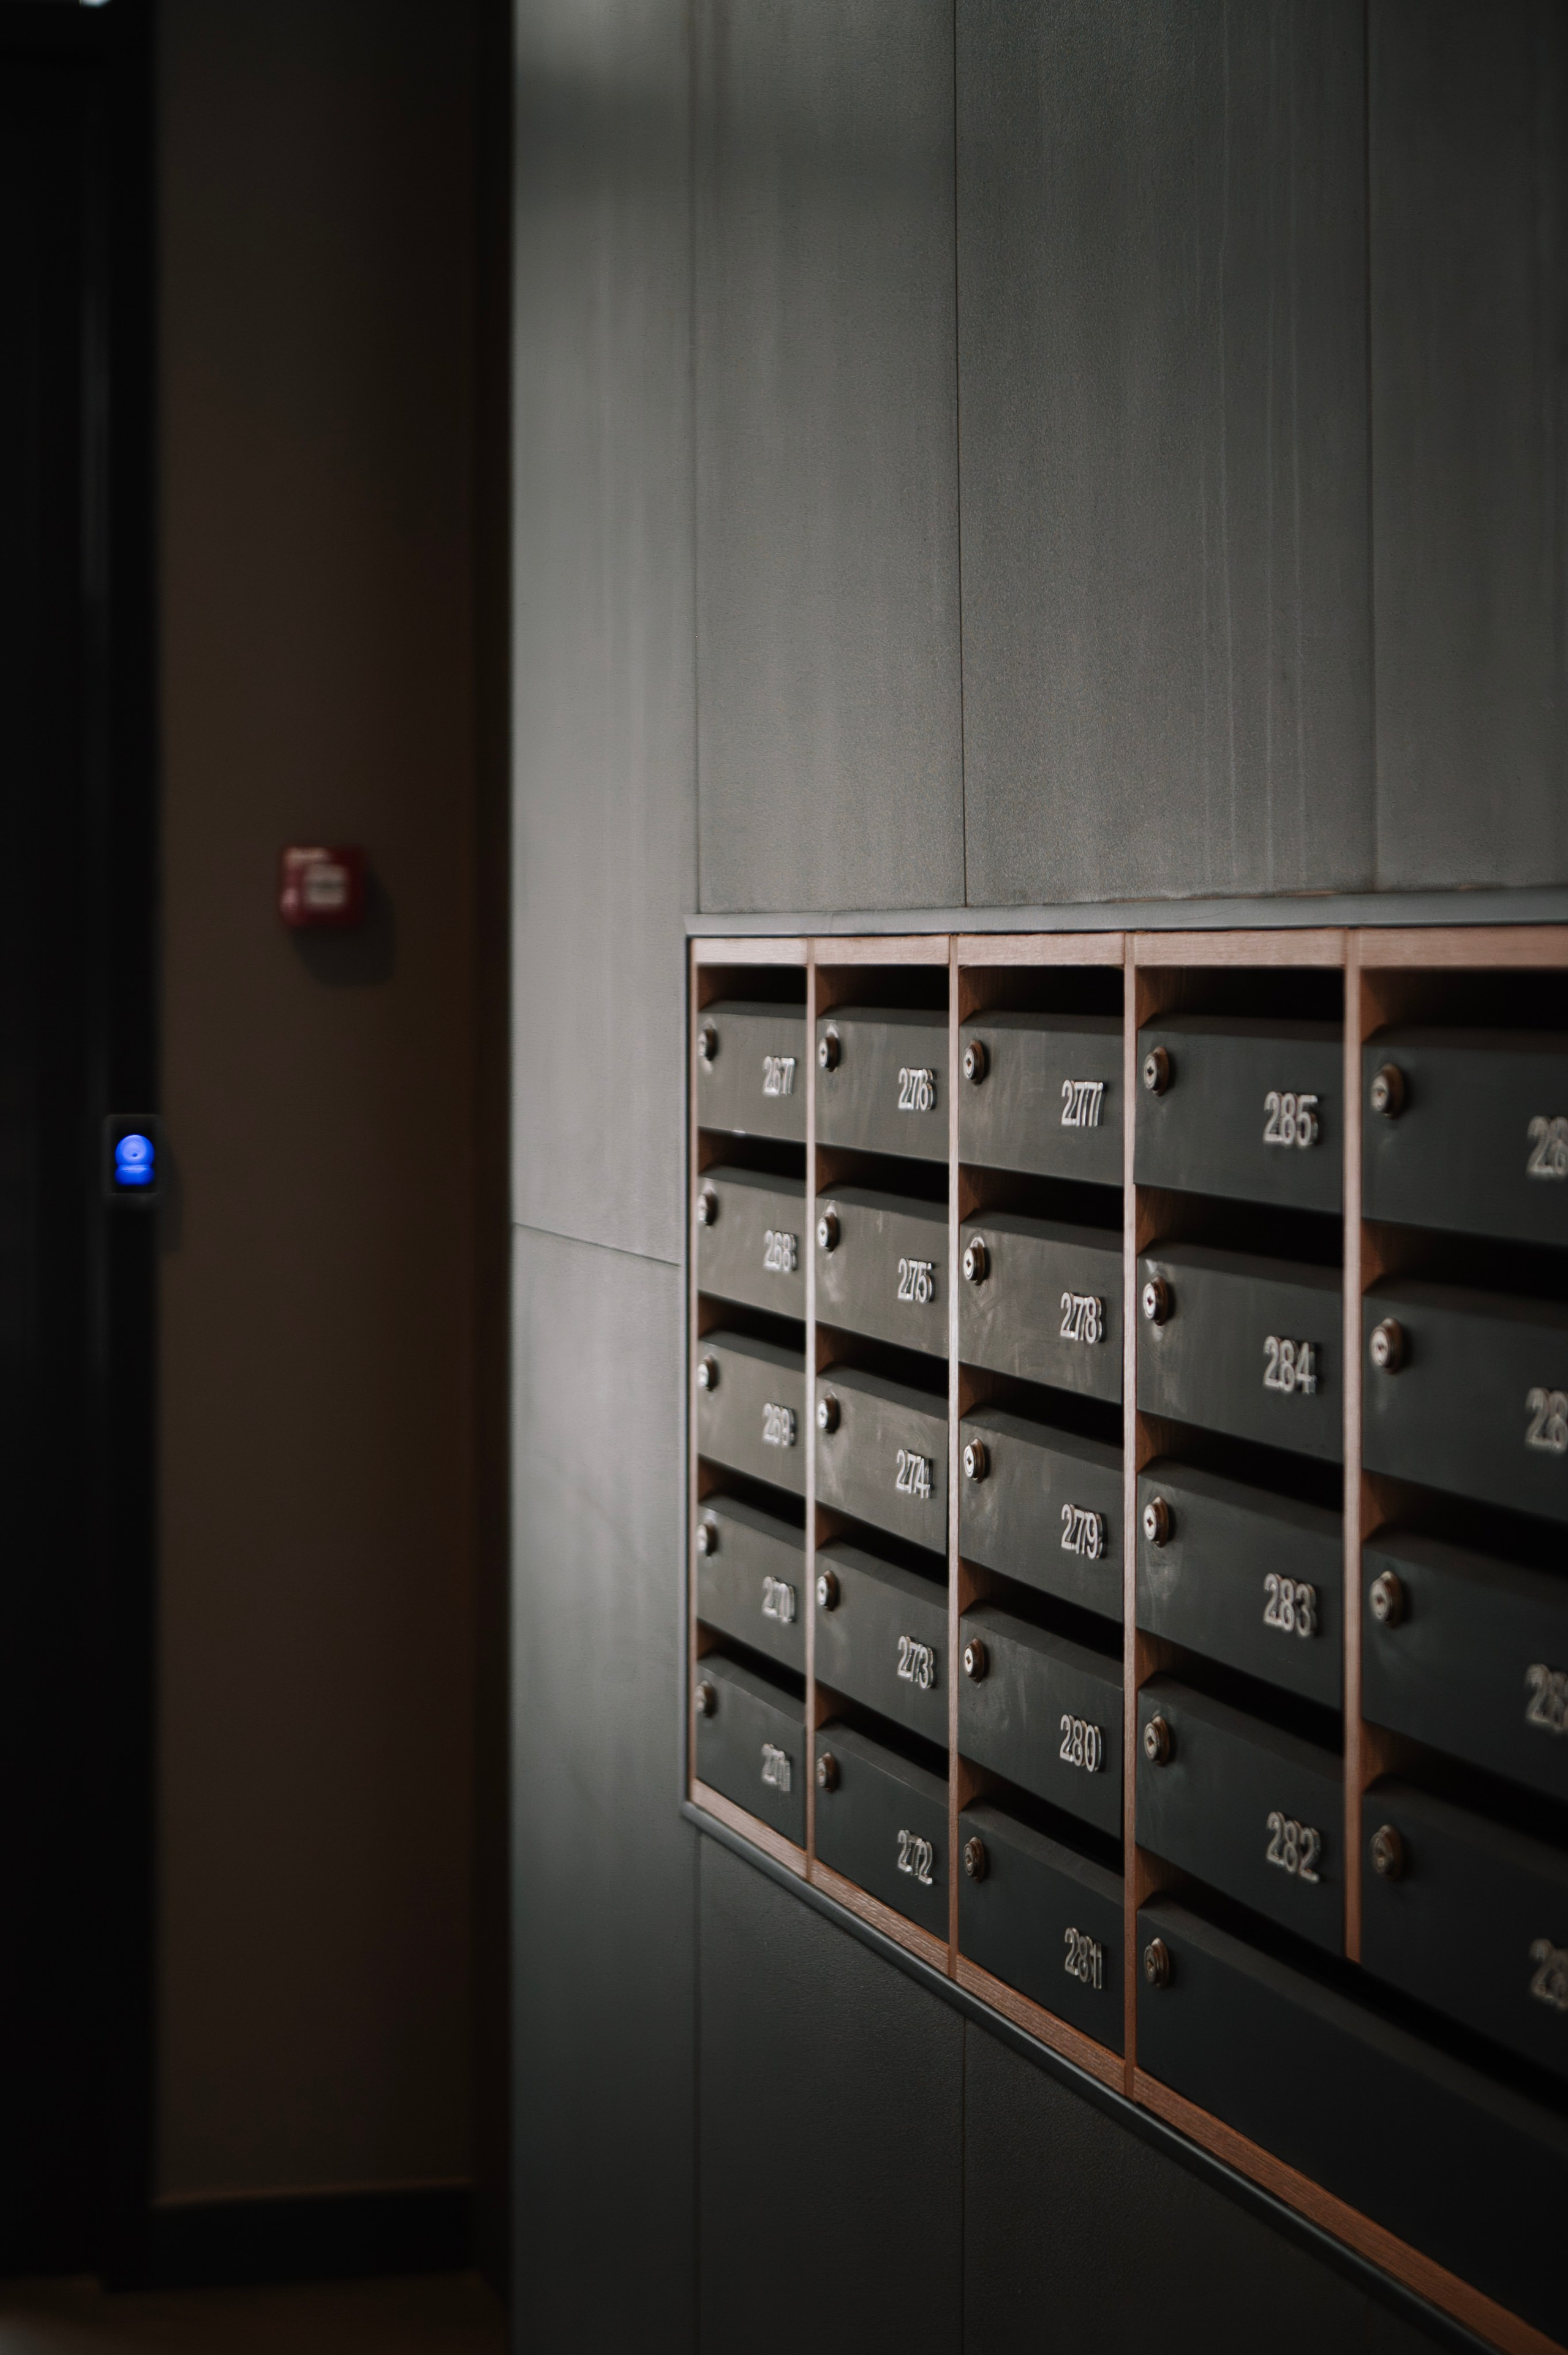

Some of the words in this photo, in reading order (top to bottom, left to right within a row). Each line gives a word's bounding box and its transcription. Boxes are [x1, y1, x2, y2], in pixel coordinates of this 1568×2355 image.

[763, 1056, 795, 1095] 267
[897, 1067, 933, 1110] 276
[1061, 1079, 1103, 1126] 277
[1263, 1091, 1318, 1146] 285
[763, 1230, 797, 1271] 268
[898, 1258, 932, 1302] 275
[1060, 1292, 1102, 1344] 278
[1263, 1336, 1317, 1394] 284
[762, 1403, 796, 1446] 269
[895, 1449, 931, 1499] 274
[1061, 1503, 1102, 1559] 279
[762, 1576, 794, 1624] 270
[1263, 1573, 1317, 1638] 283
[897, 1636, 933, 1689] 273
[1060, 1714, 1101, 1772] 280
[897, 1830, 932, 1884] 272
[1265, 1812, 1321, 1883] 282
[1065, 1927, 1102, 1989] 281
